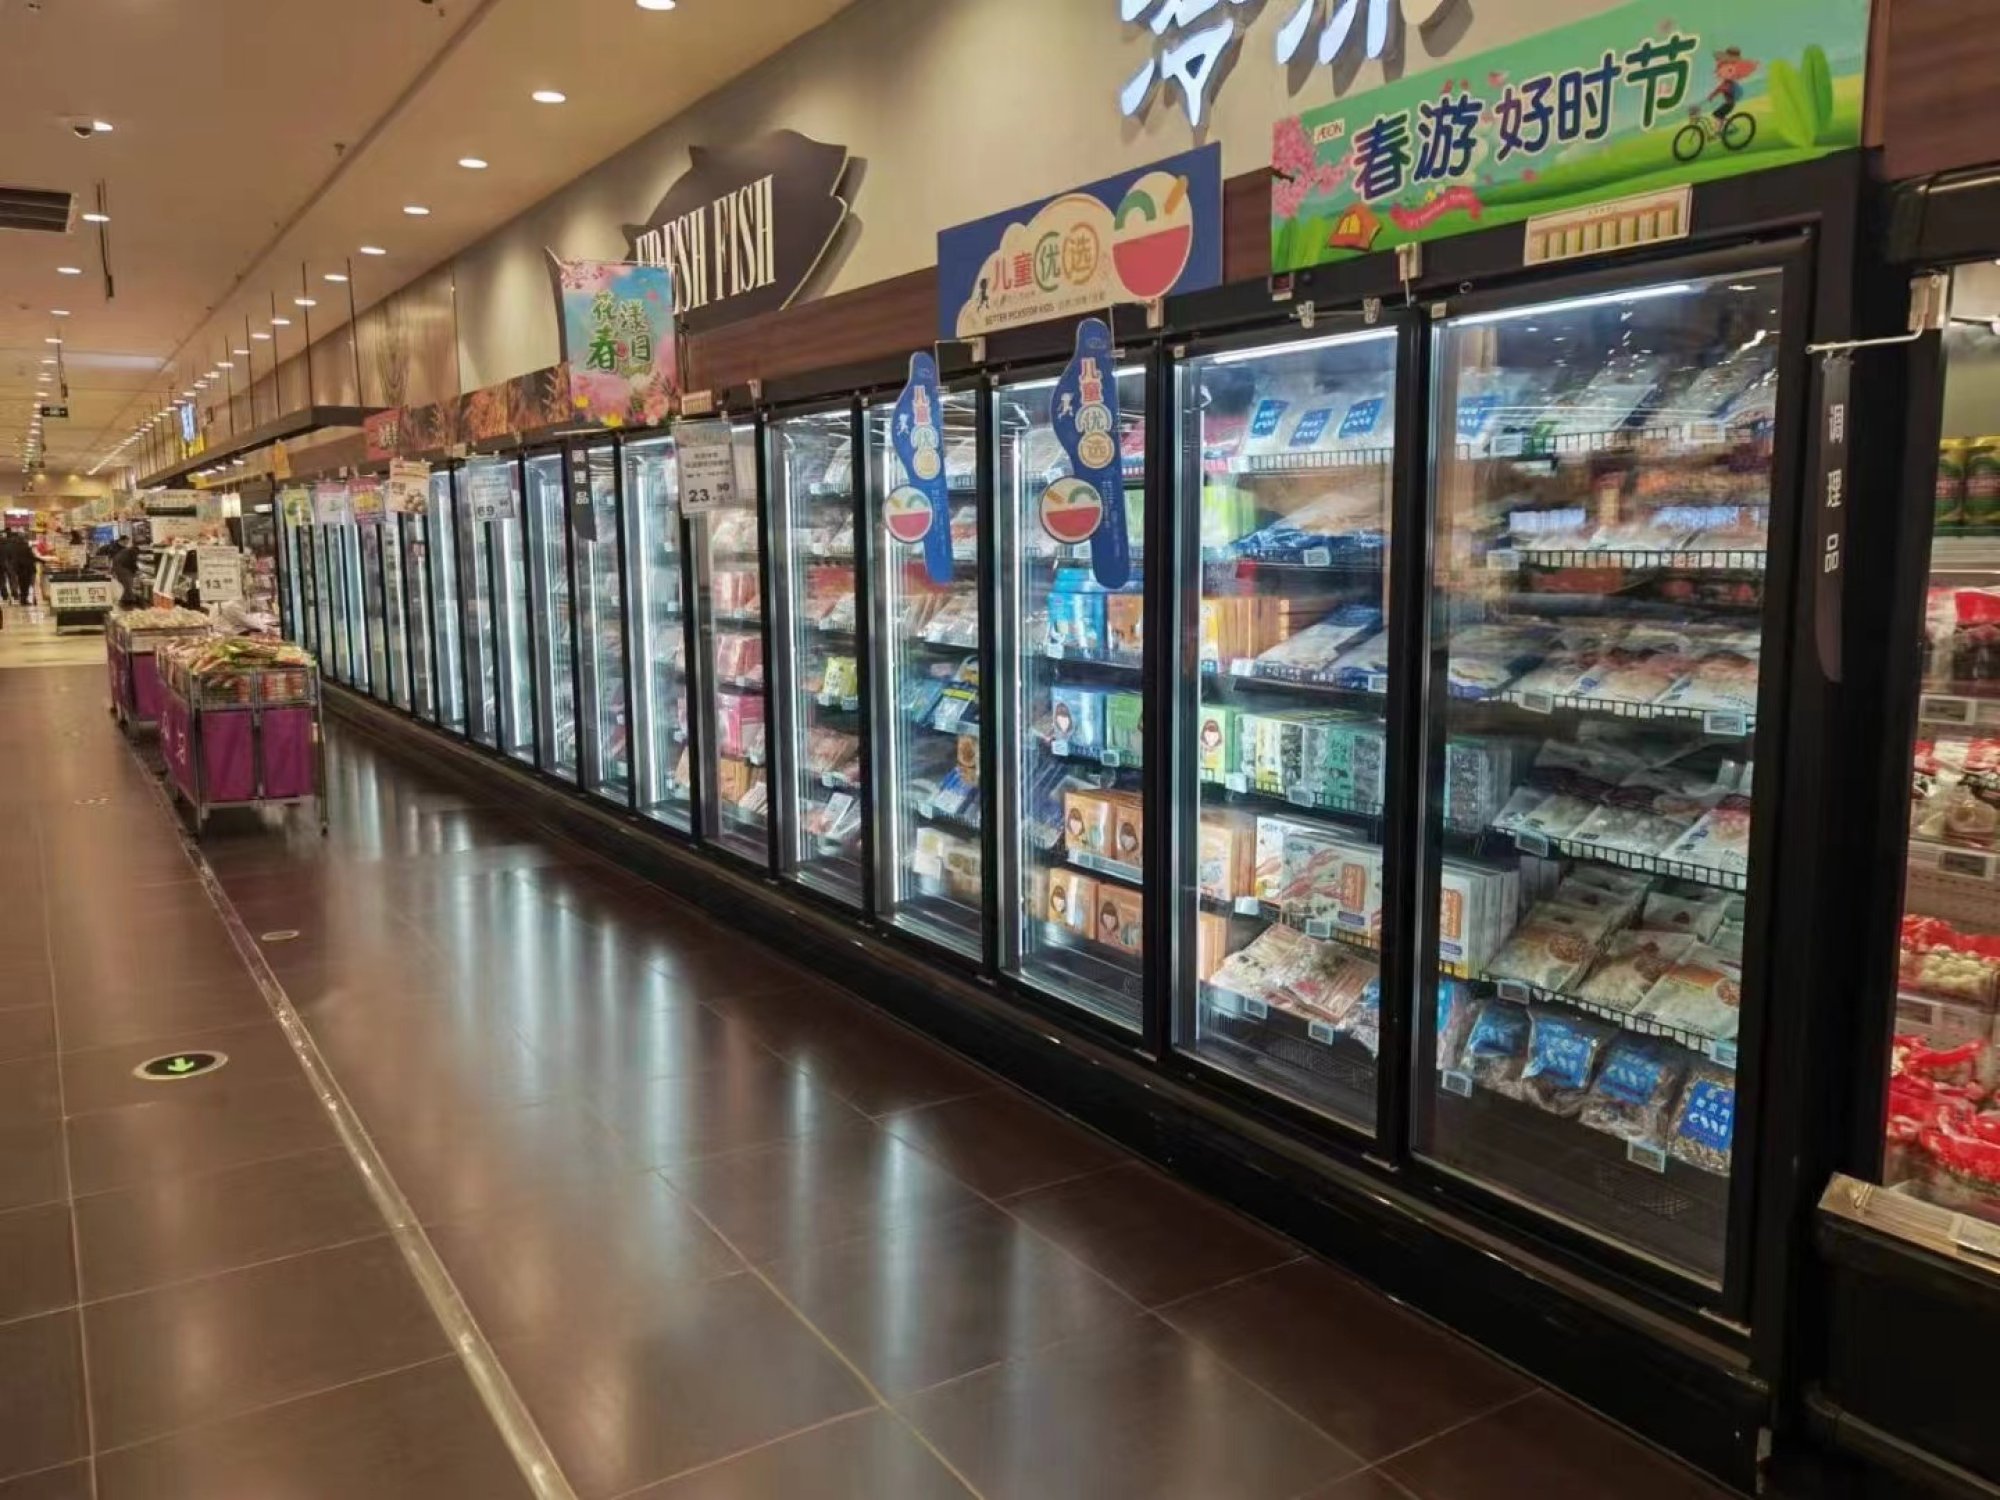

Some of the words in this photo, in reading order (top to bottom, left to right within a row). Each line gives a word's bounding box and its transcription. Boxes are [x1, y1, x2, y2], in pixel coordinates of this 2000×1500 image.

[1352, 34, 1698, 199] 春游好时节
[713, 174, 776, 300] FISH
[991, 221, 1099, 292] 儿童优选
